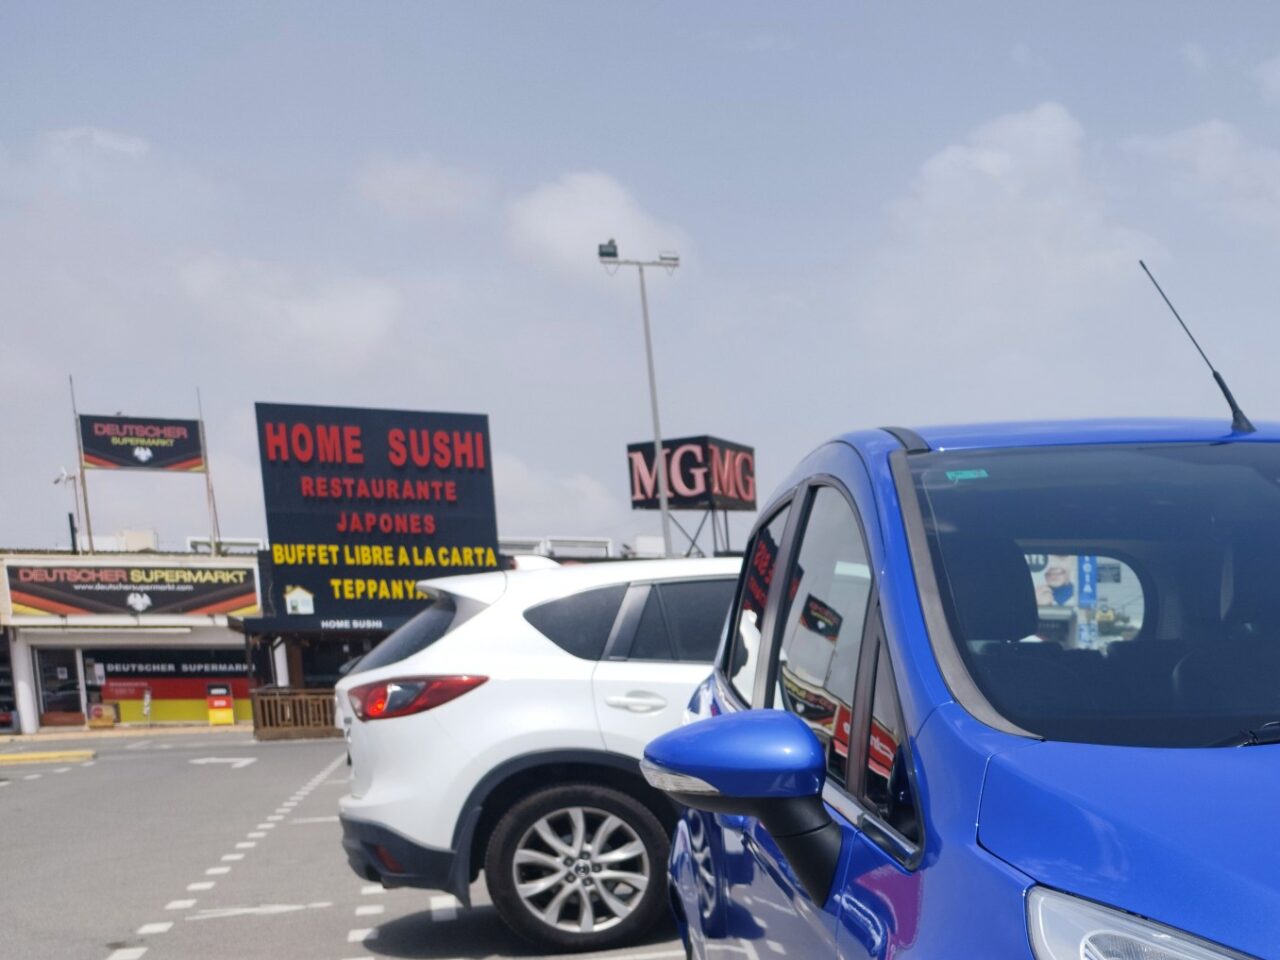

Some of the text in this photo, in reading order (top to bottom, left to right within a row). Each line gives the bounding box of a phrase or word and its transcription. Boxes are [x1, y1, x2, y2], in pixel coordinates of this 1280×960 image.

[93, 423, 188, 438] DEUTSCHER
[264, 422, 486, 470] HOME SUSHI
[628, 444, 708, 501] MG
[708, 443, 756, 502] MG
[301, 476, 457, 502] RESTAURANTE
[336, 511, 436, 534] JAPONES
[272, 543, 498, 568] BUFFET LIBRE A LA CARTA
[19, 568, 247, 584] DEUTSCHER SUPERMARKT
[321, 619, 383, 629] HOME SUSHI
[106, 663, 176, 673] DEUTSCHER
